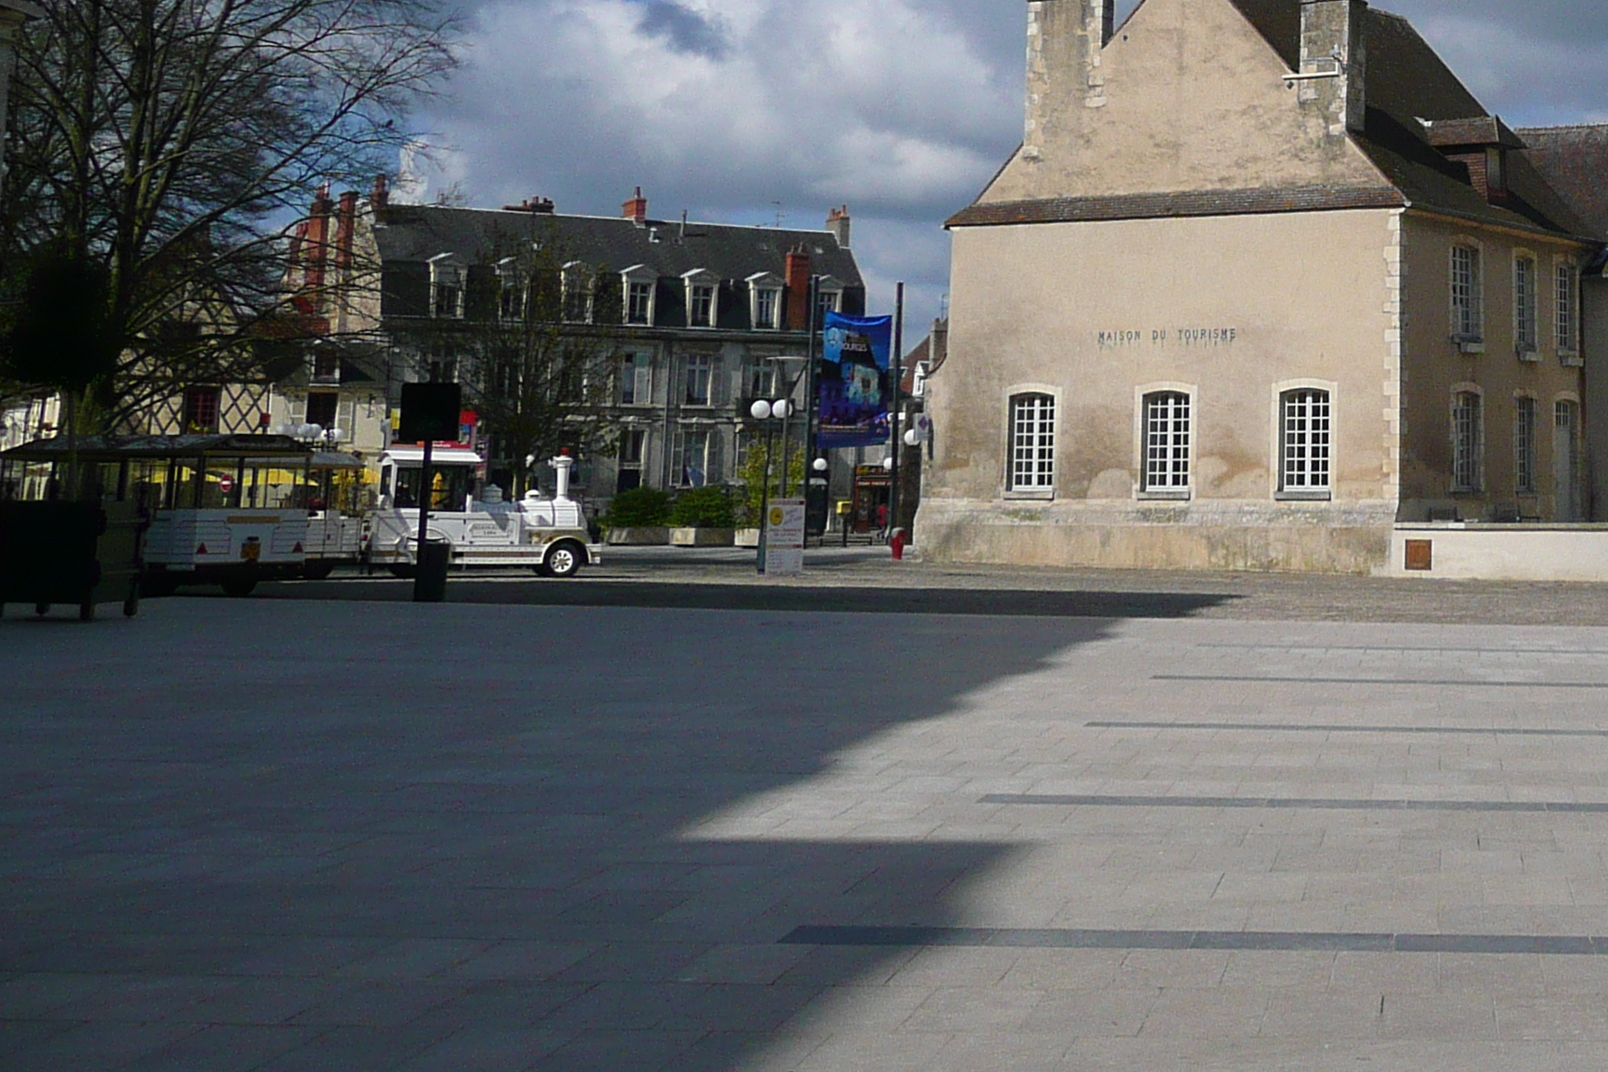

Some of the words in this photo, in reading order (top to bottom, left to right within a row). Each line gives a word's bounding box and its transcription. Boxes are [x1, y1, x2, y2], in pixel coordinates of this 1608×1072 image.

[1098, 330, 1141, 342] MAISON
[1152, 329, 1167, 341] DU
[1178, 328, 1236, 341] TOURISME
